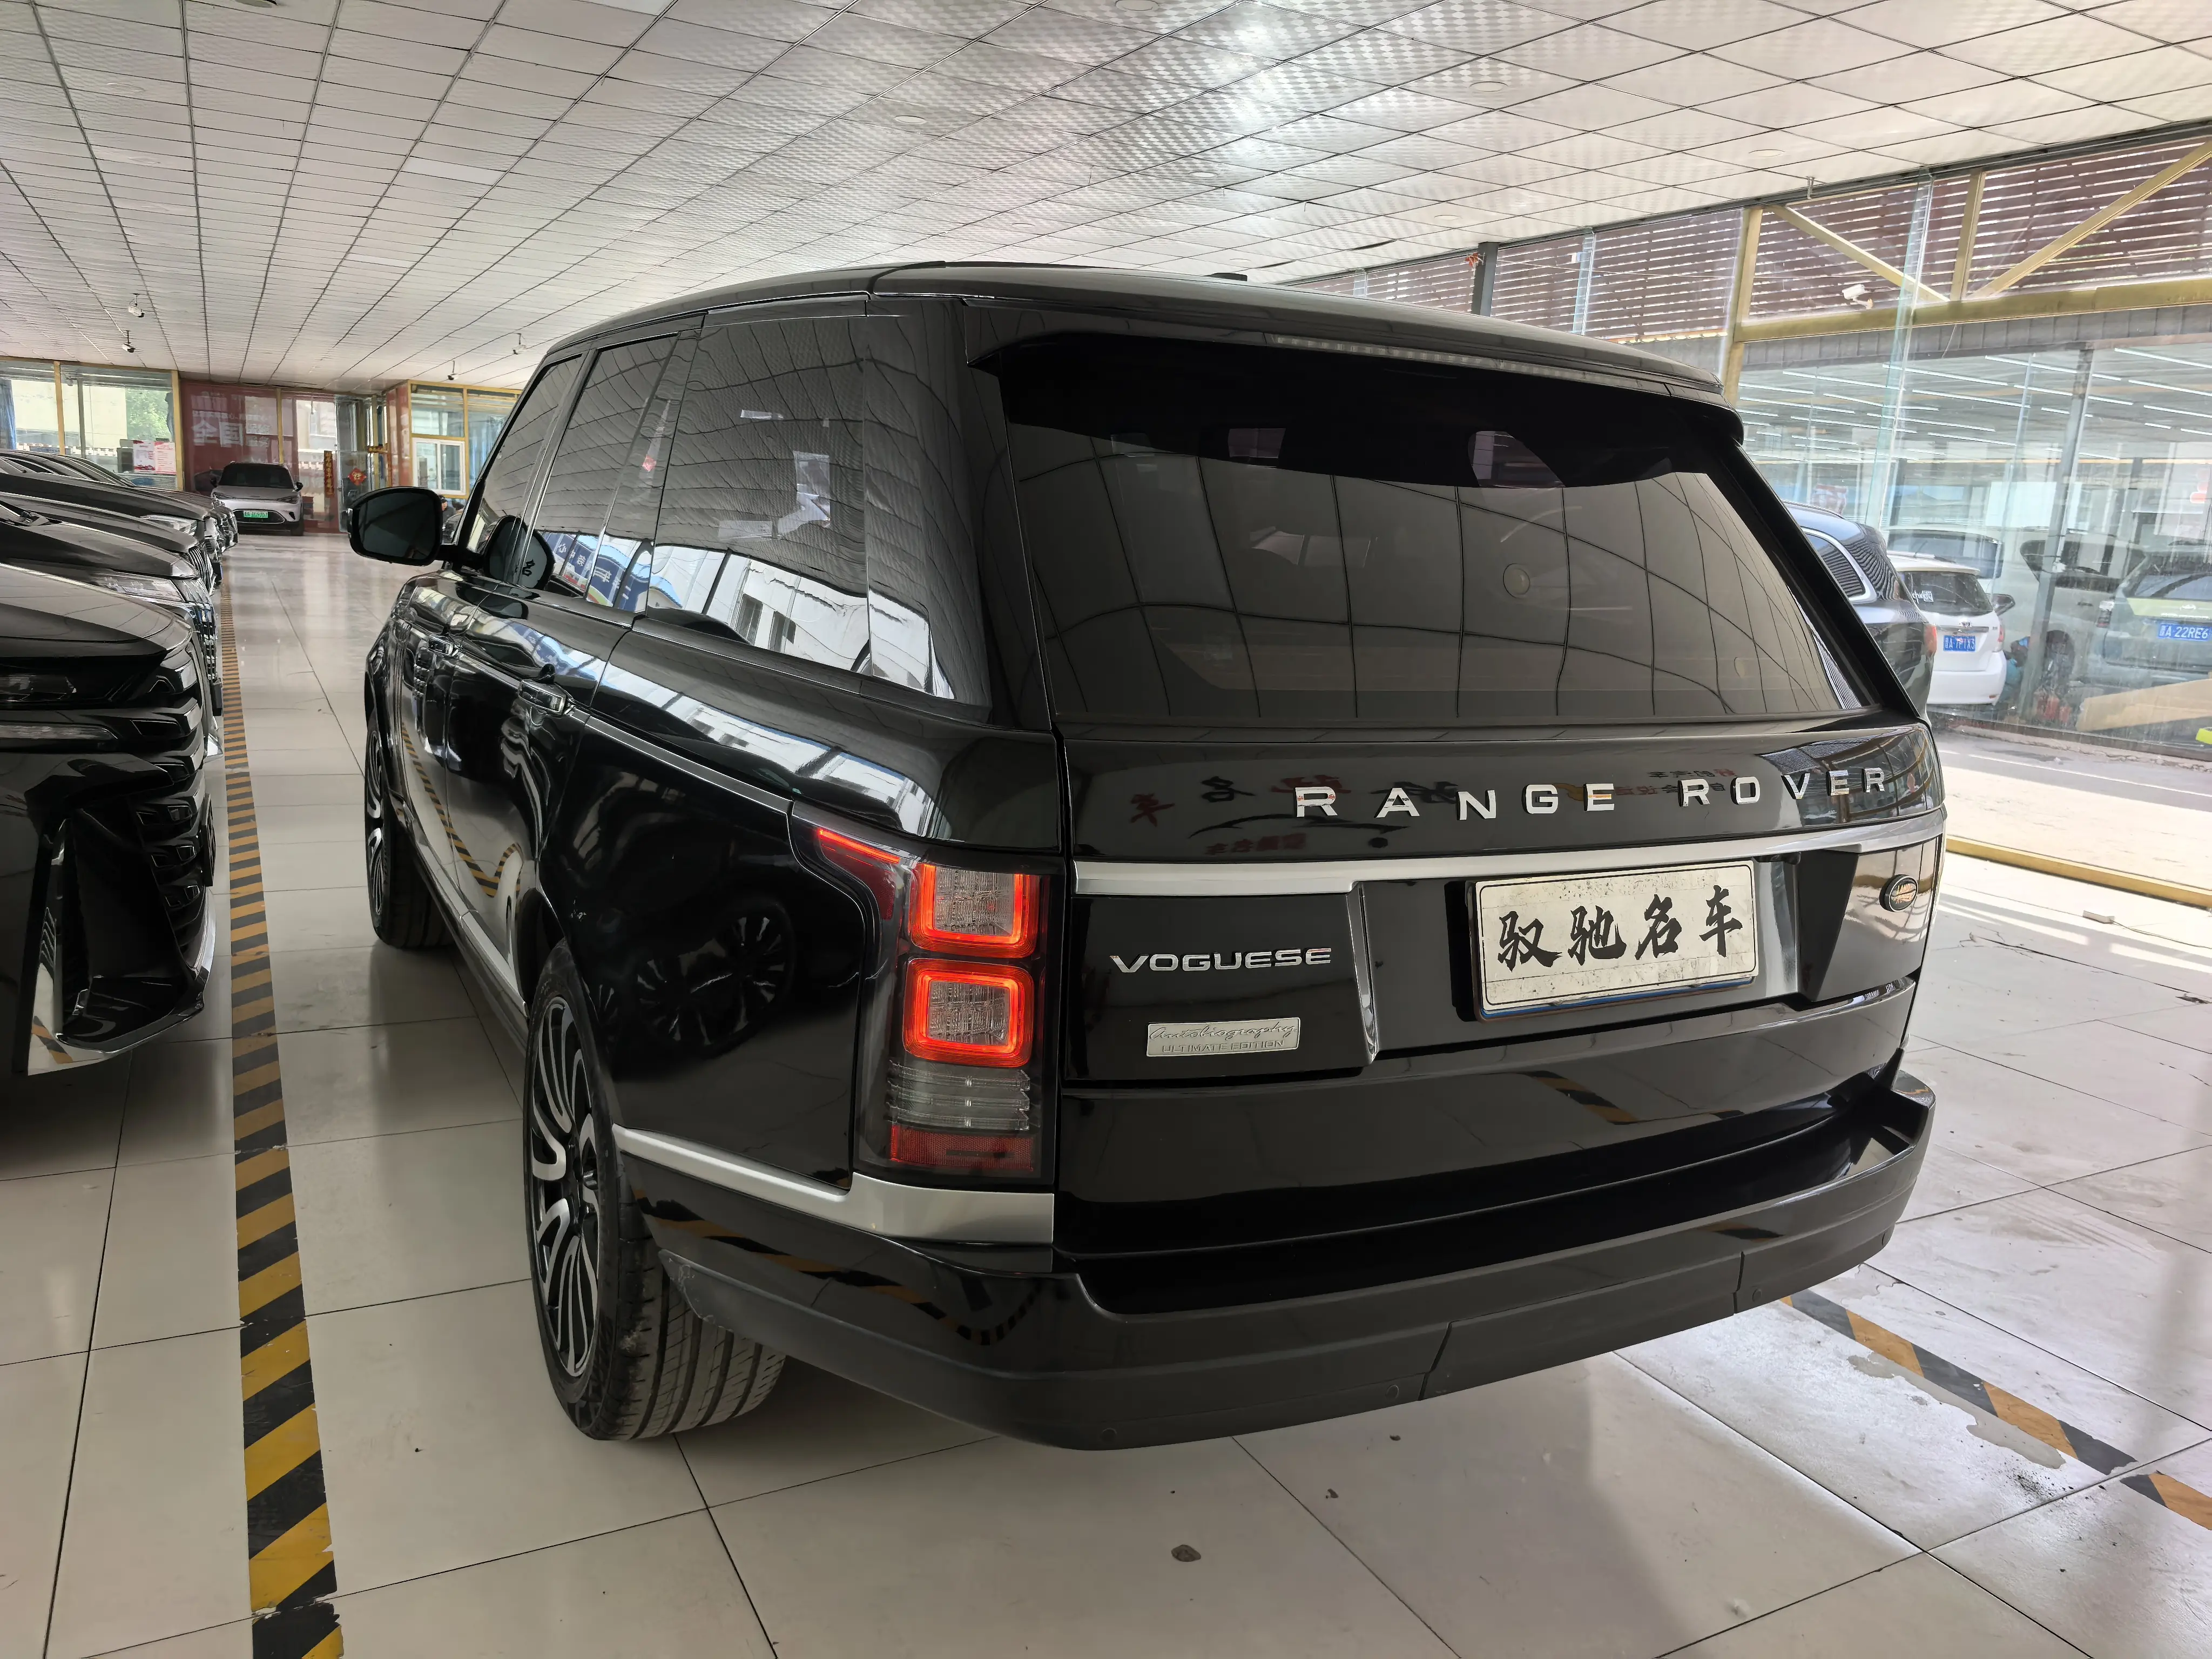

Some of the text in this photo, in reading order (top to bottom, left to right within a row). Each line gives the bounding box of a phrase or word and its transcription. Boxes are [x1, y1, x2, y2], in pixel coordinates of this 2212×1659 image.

[1294, 783, 1615, 820] RANGE
[1678, 767, 1885, 807] ROVER
[1498, 885, 1743, 972] 驭驰名车
[1109, 948, 1332, 973] VOGUESE
[1149, 1022, 1298, 1041] Autobiography
[1162, 1040, 1285, 1053] ULTIMATE EDITION
